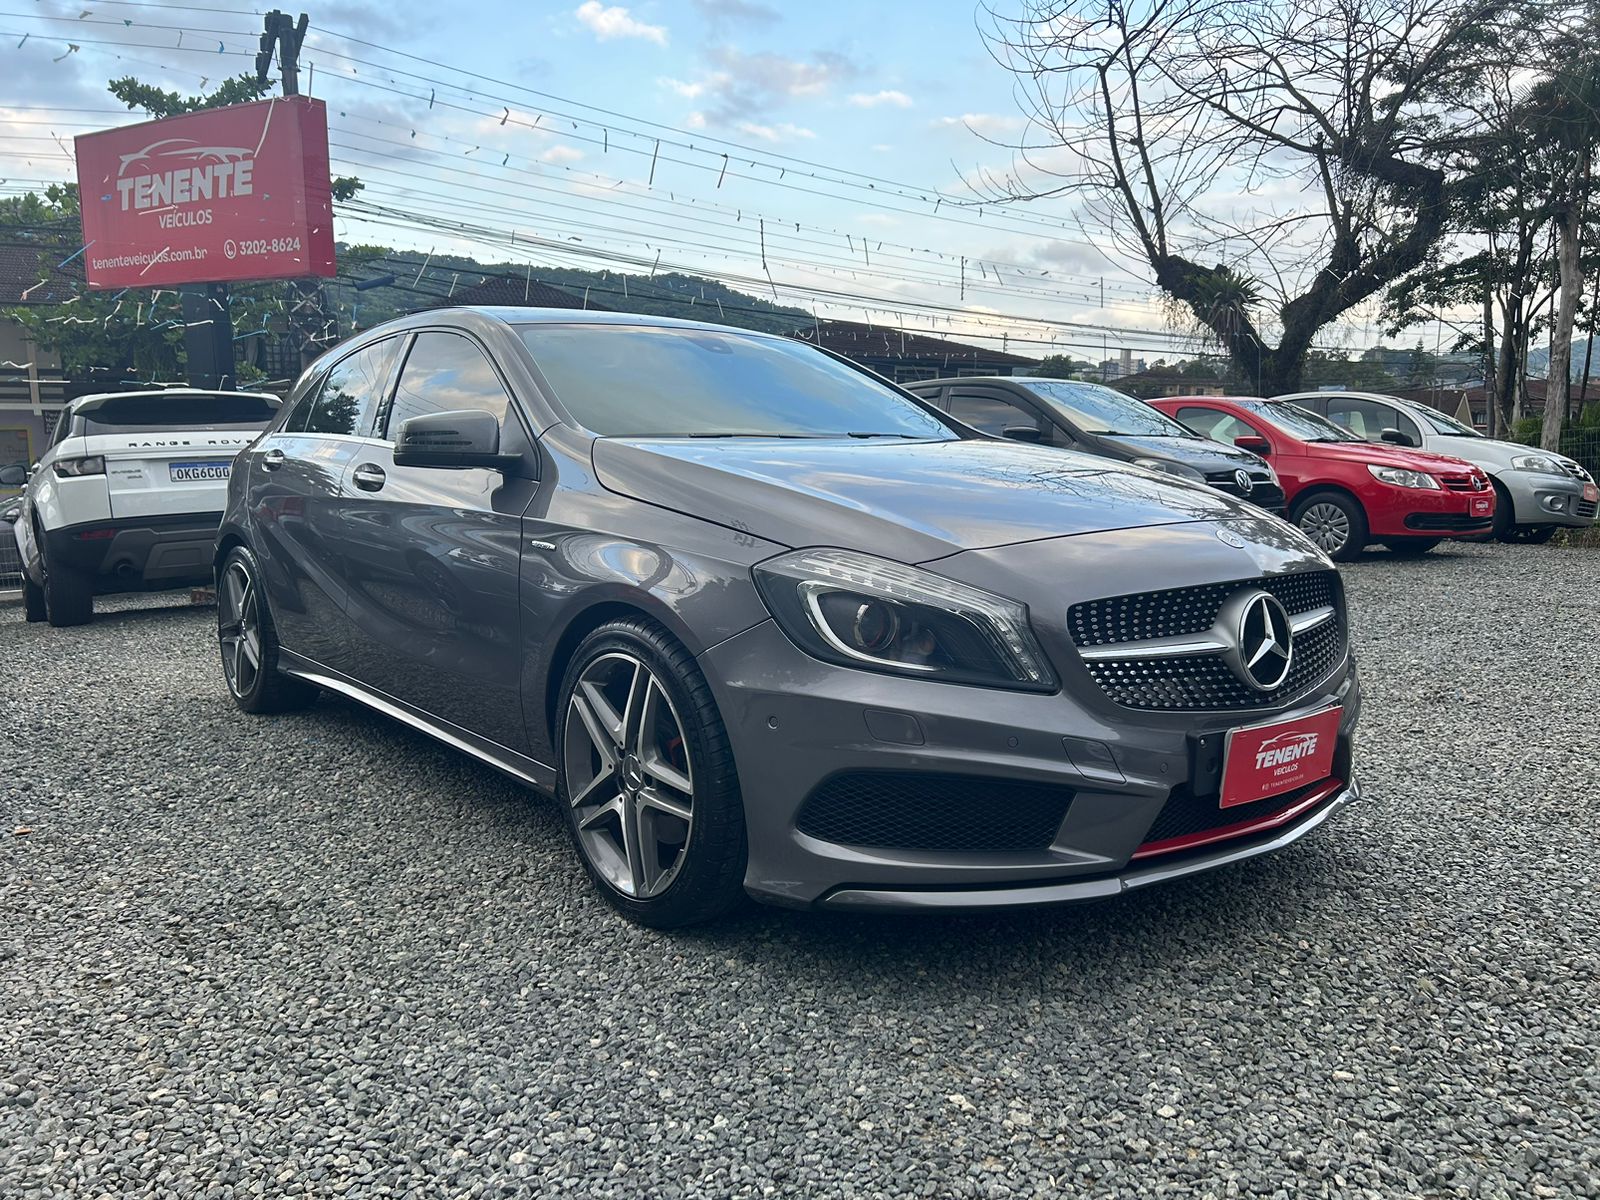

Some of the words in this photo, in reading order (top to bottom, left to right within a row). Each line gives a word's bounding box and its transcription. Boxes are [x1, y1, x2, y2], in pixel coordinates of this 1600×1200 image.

[117, 160, 254, 211] TENENTE
[159, 209, 213, 229] VEÍCULOS
[239, 236, 301, 256] 3202-8624
[92, 247, 208, 270] tenenteveiculos.com.br
[128, 440, 191, 448] RANGE
[1256, 738, 1317, 769] TENENTE
